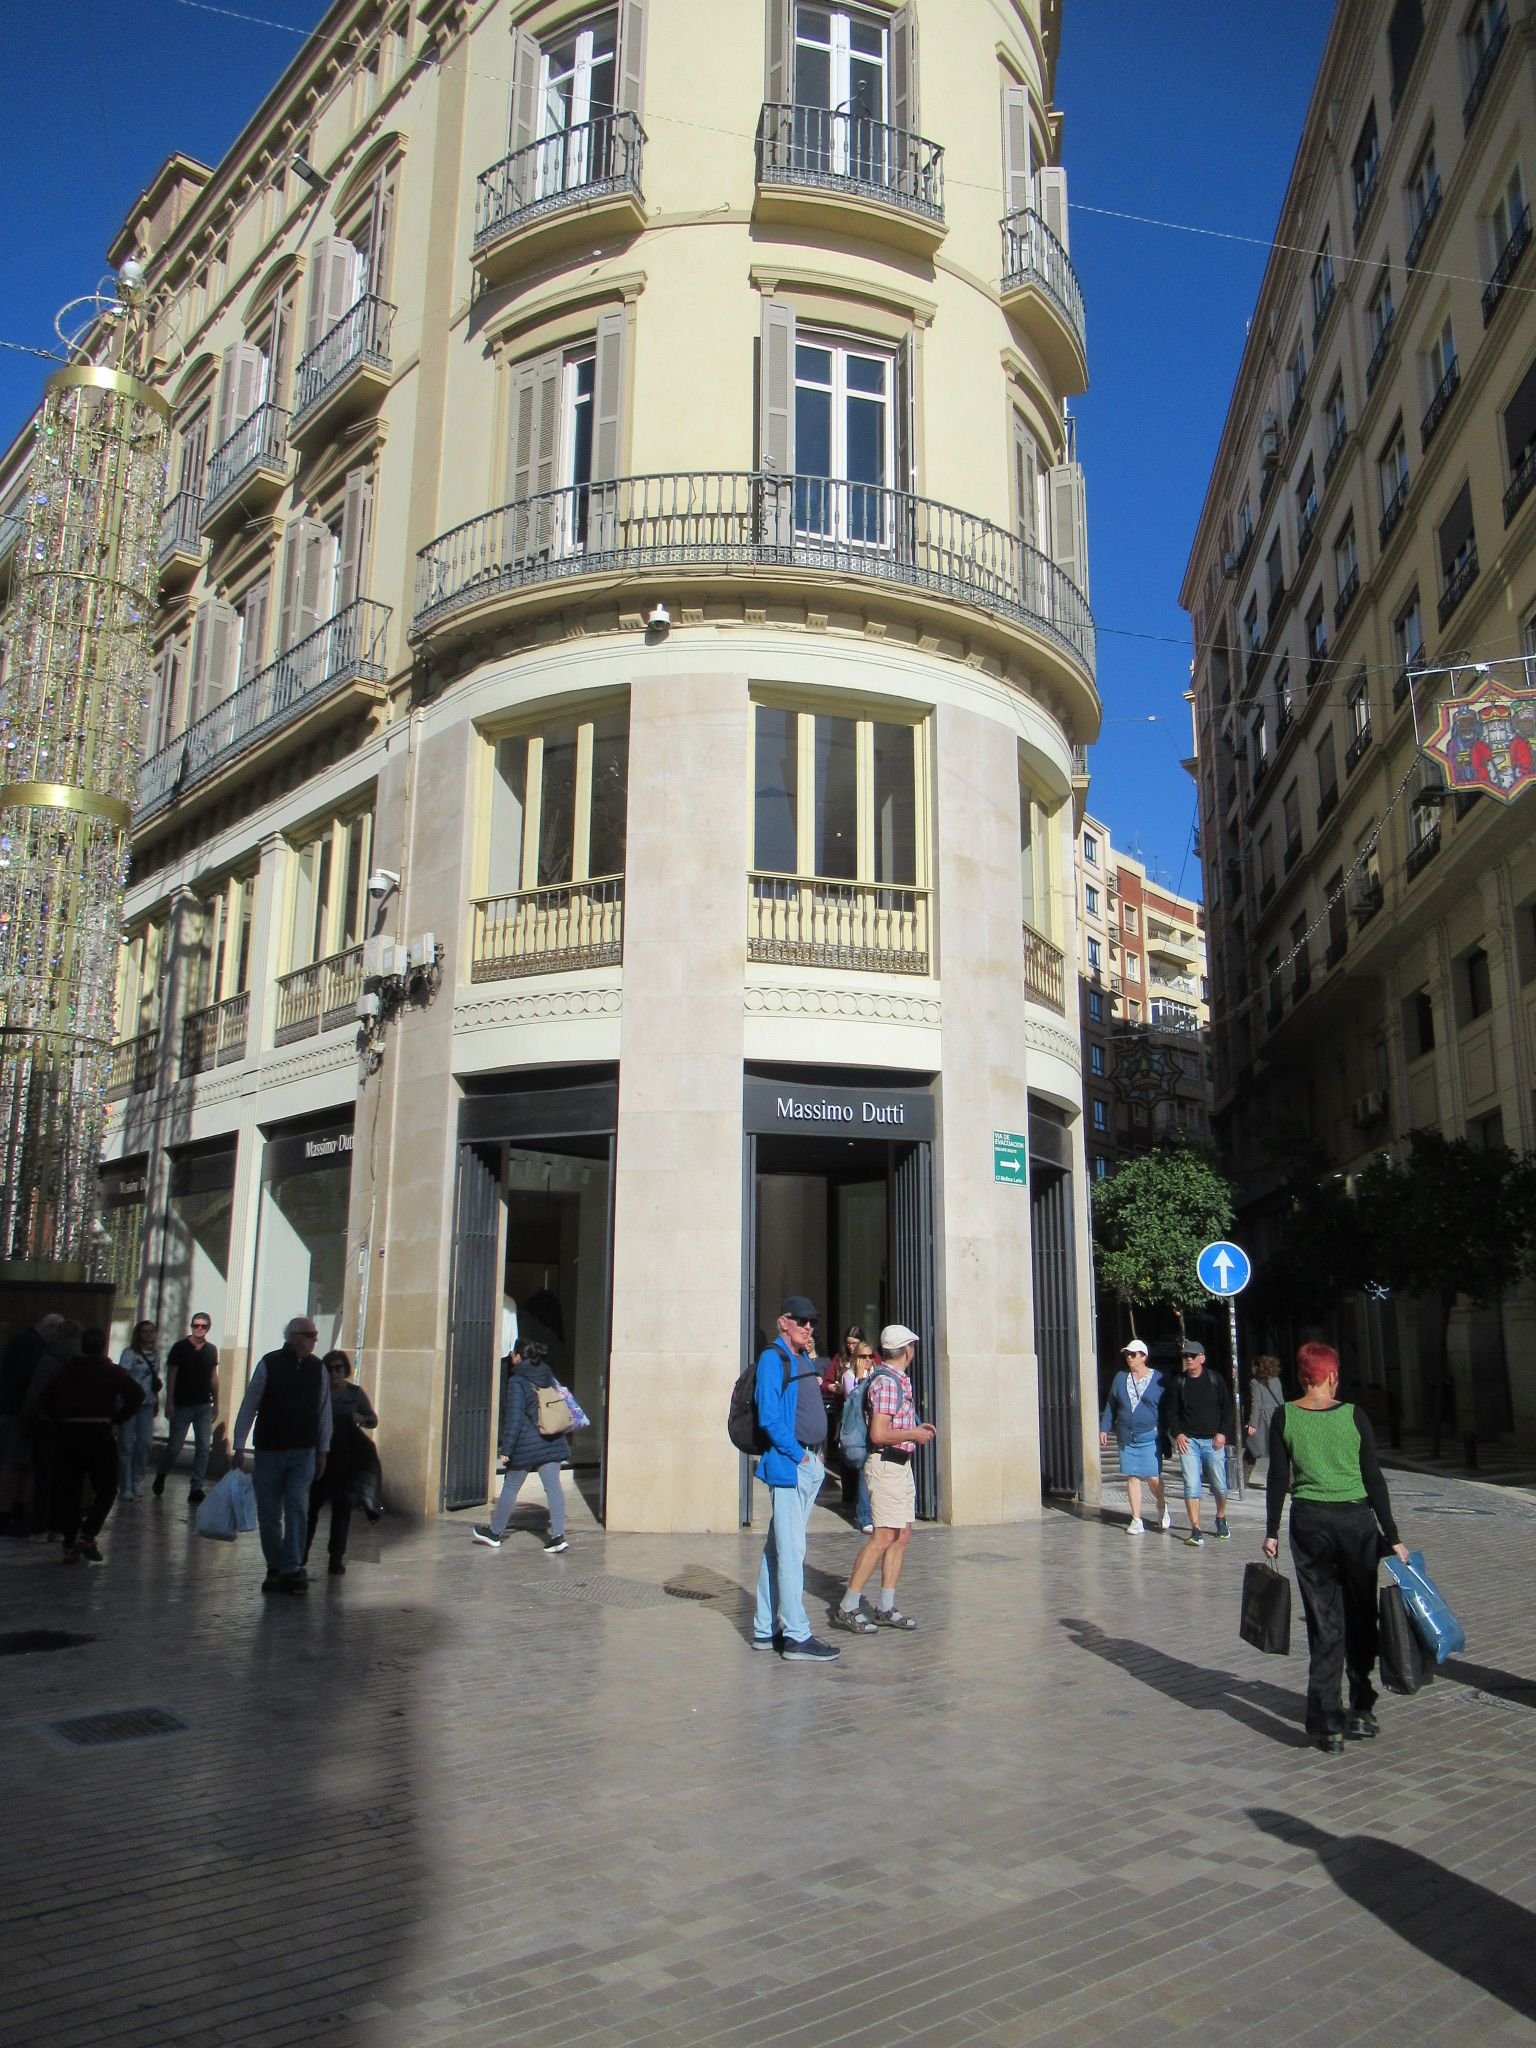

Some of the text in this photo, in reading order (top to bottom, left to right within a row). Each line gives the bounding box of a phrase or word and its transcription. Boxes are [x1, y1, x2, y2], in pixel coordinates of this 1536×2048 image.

[777, 1097, 904, 1124] Massimo Dutti
[305, 1137, 337, 1158] Massimo
